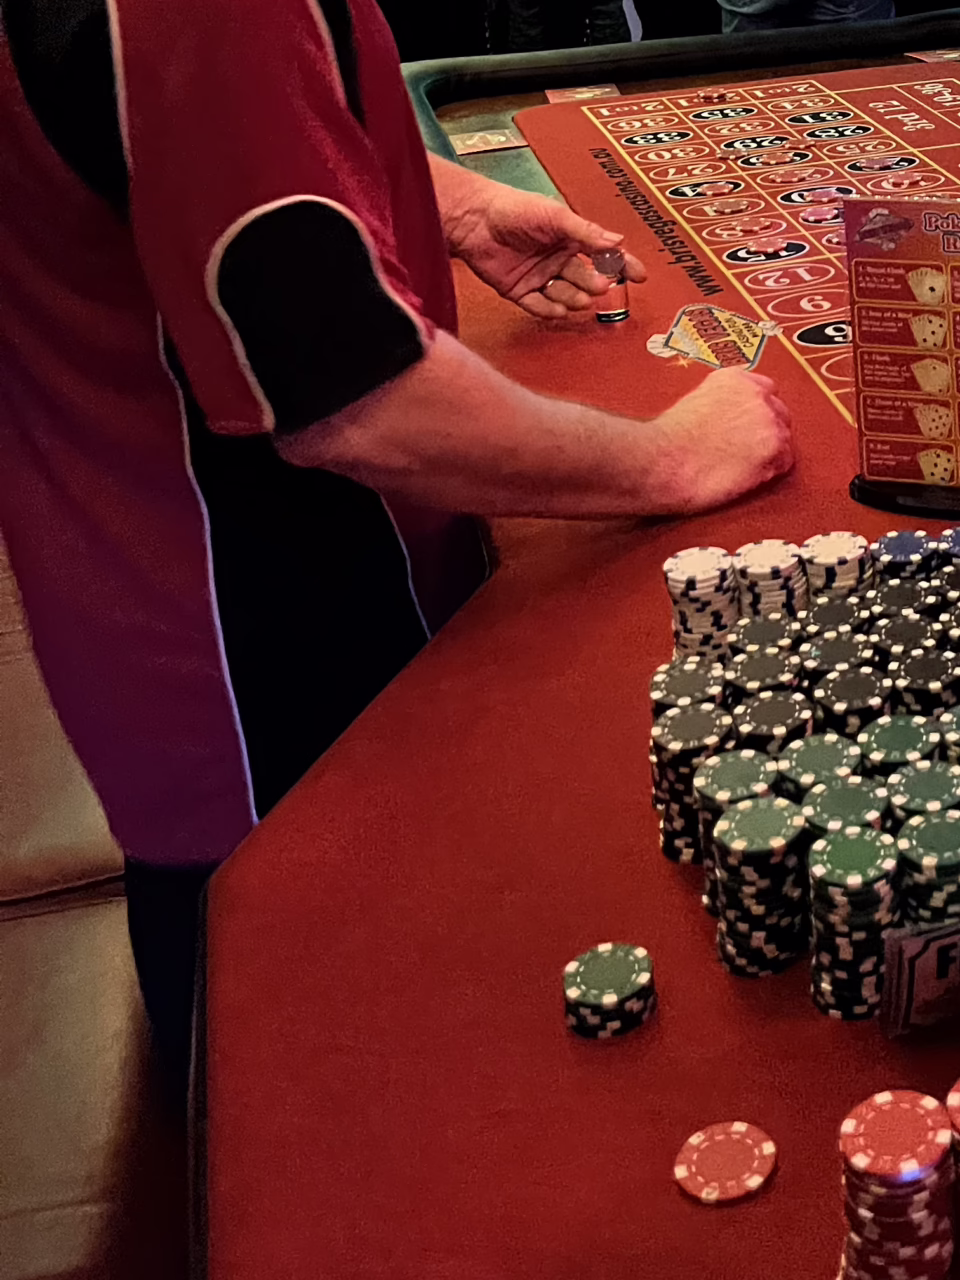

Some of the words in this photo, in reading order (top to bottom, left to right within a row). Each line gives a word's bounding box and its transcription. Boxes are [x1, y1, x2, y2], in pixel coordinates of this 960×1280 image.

[778, 97, 825, 110] 34
[868, 100, 908, 119] 12
[700, 108, 745, 119] 35
[801, 112, 844, 123] 31
[617, 117, 667, 130] 36
[715, 120, 764, 134] 32
[894, 112, 936, 132] 3rd
[632, 131, 680, 145] 33
[815, 125, 865, 138] 28
[734, 135, 784, 150] 29
[835, 141, 883, 154] 25
[647, 147, 697, 161] 30
[665, 163, 714, 179] 27
[758, 266, 821, 286] 12
